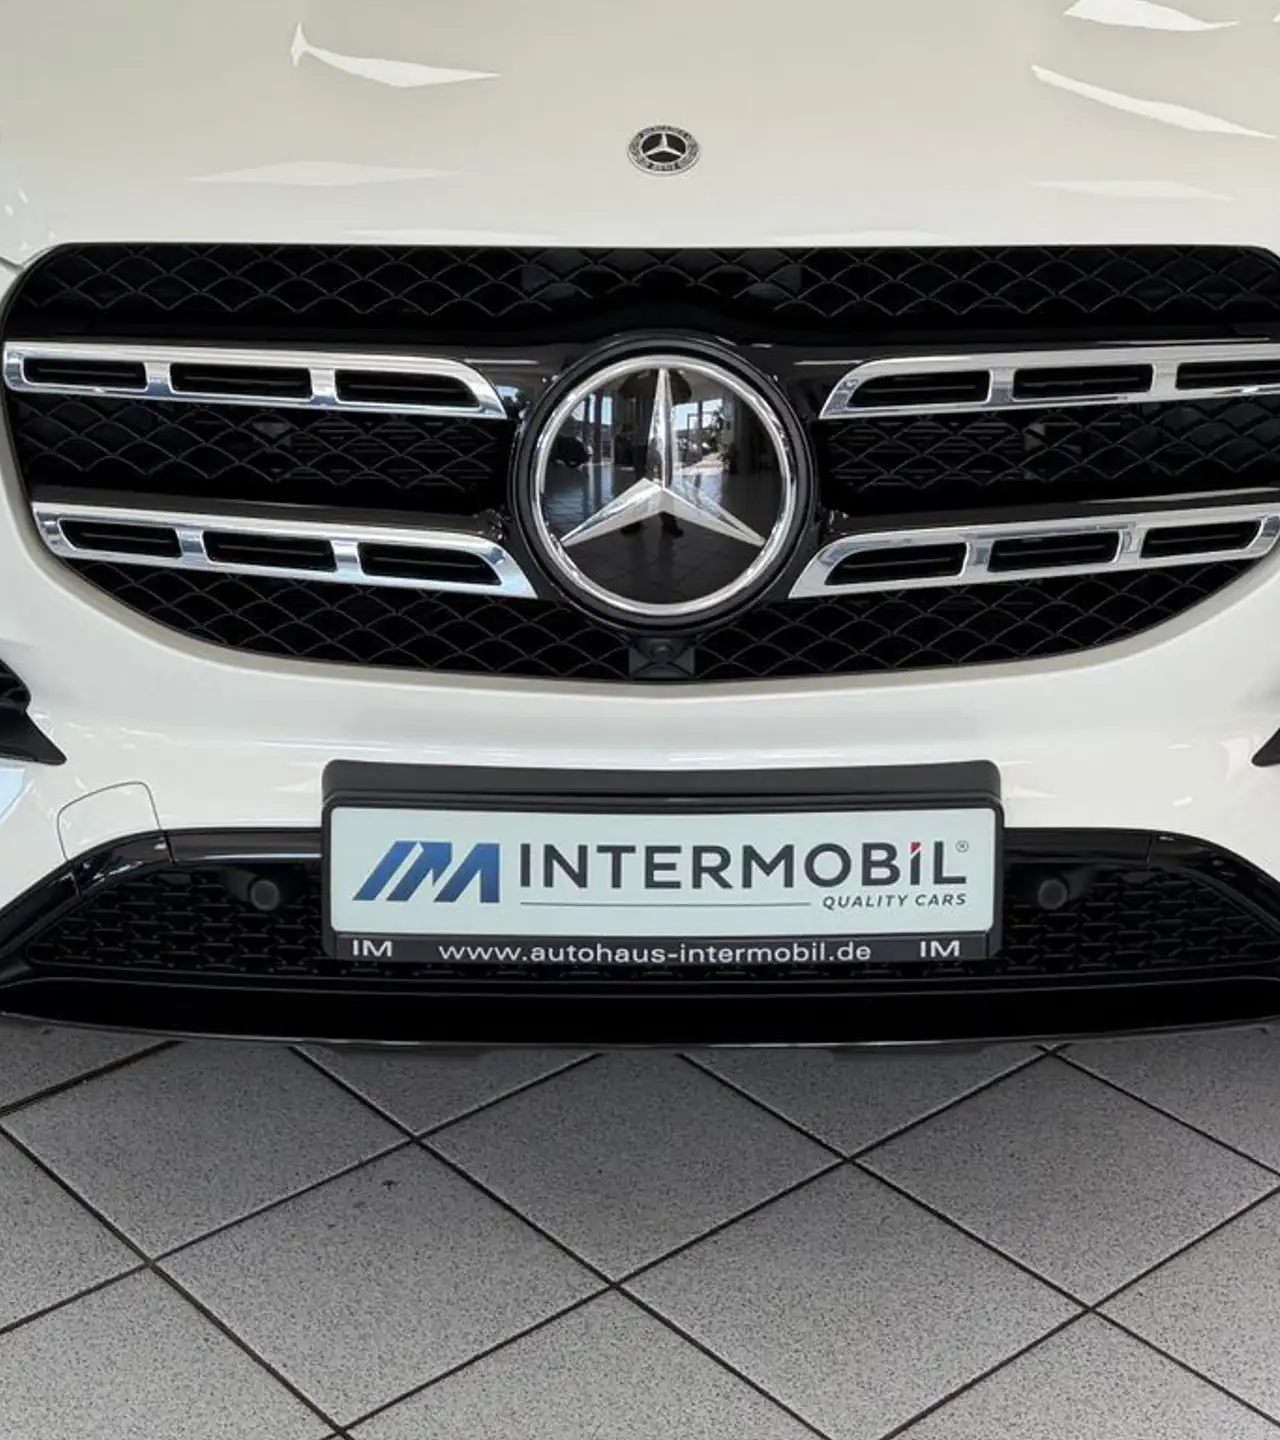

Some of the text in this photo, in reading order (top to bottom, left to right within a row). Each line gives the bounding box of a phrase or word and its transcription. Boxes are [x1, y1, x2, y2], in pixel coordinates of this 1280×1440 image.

[822, 892, 967, 911] QUALITY CARS
[352, 939, 961, 963] IM www.autohaus-intermobil.de IM
